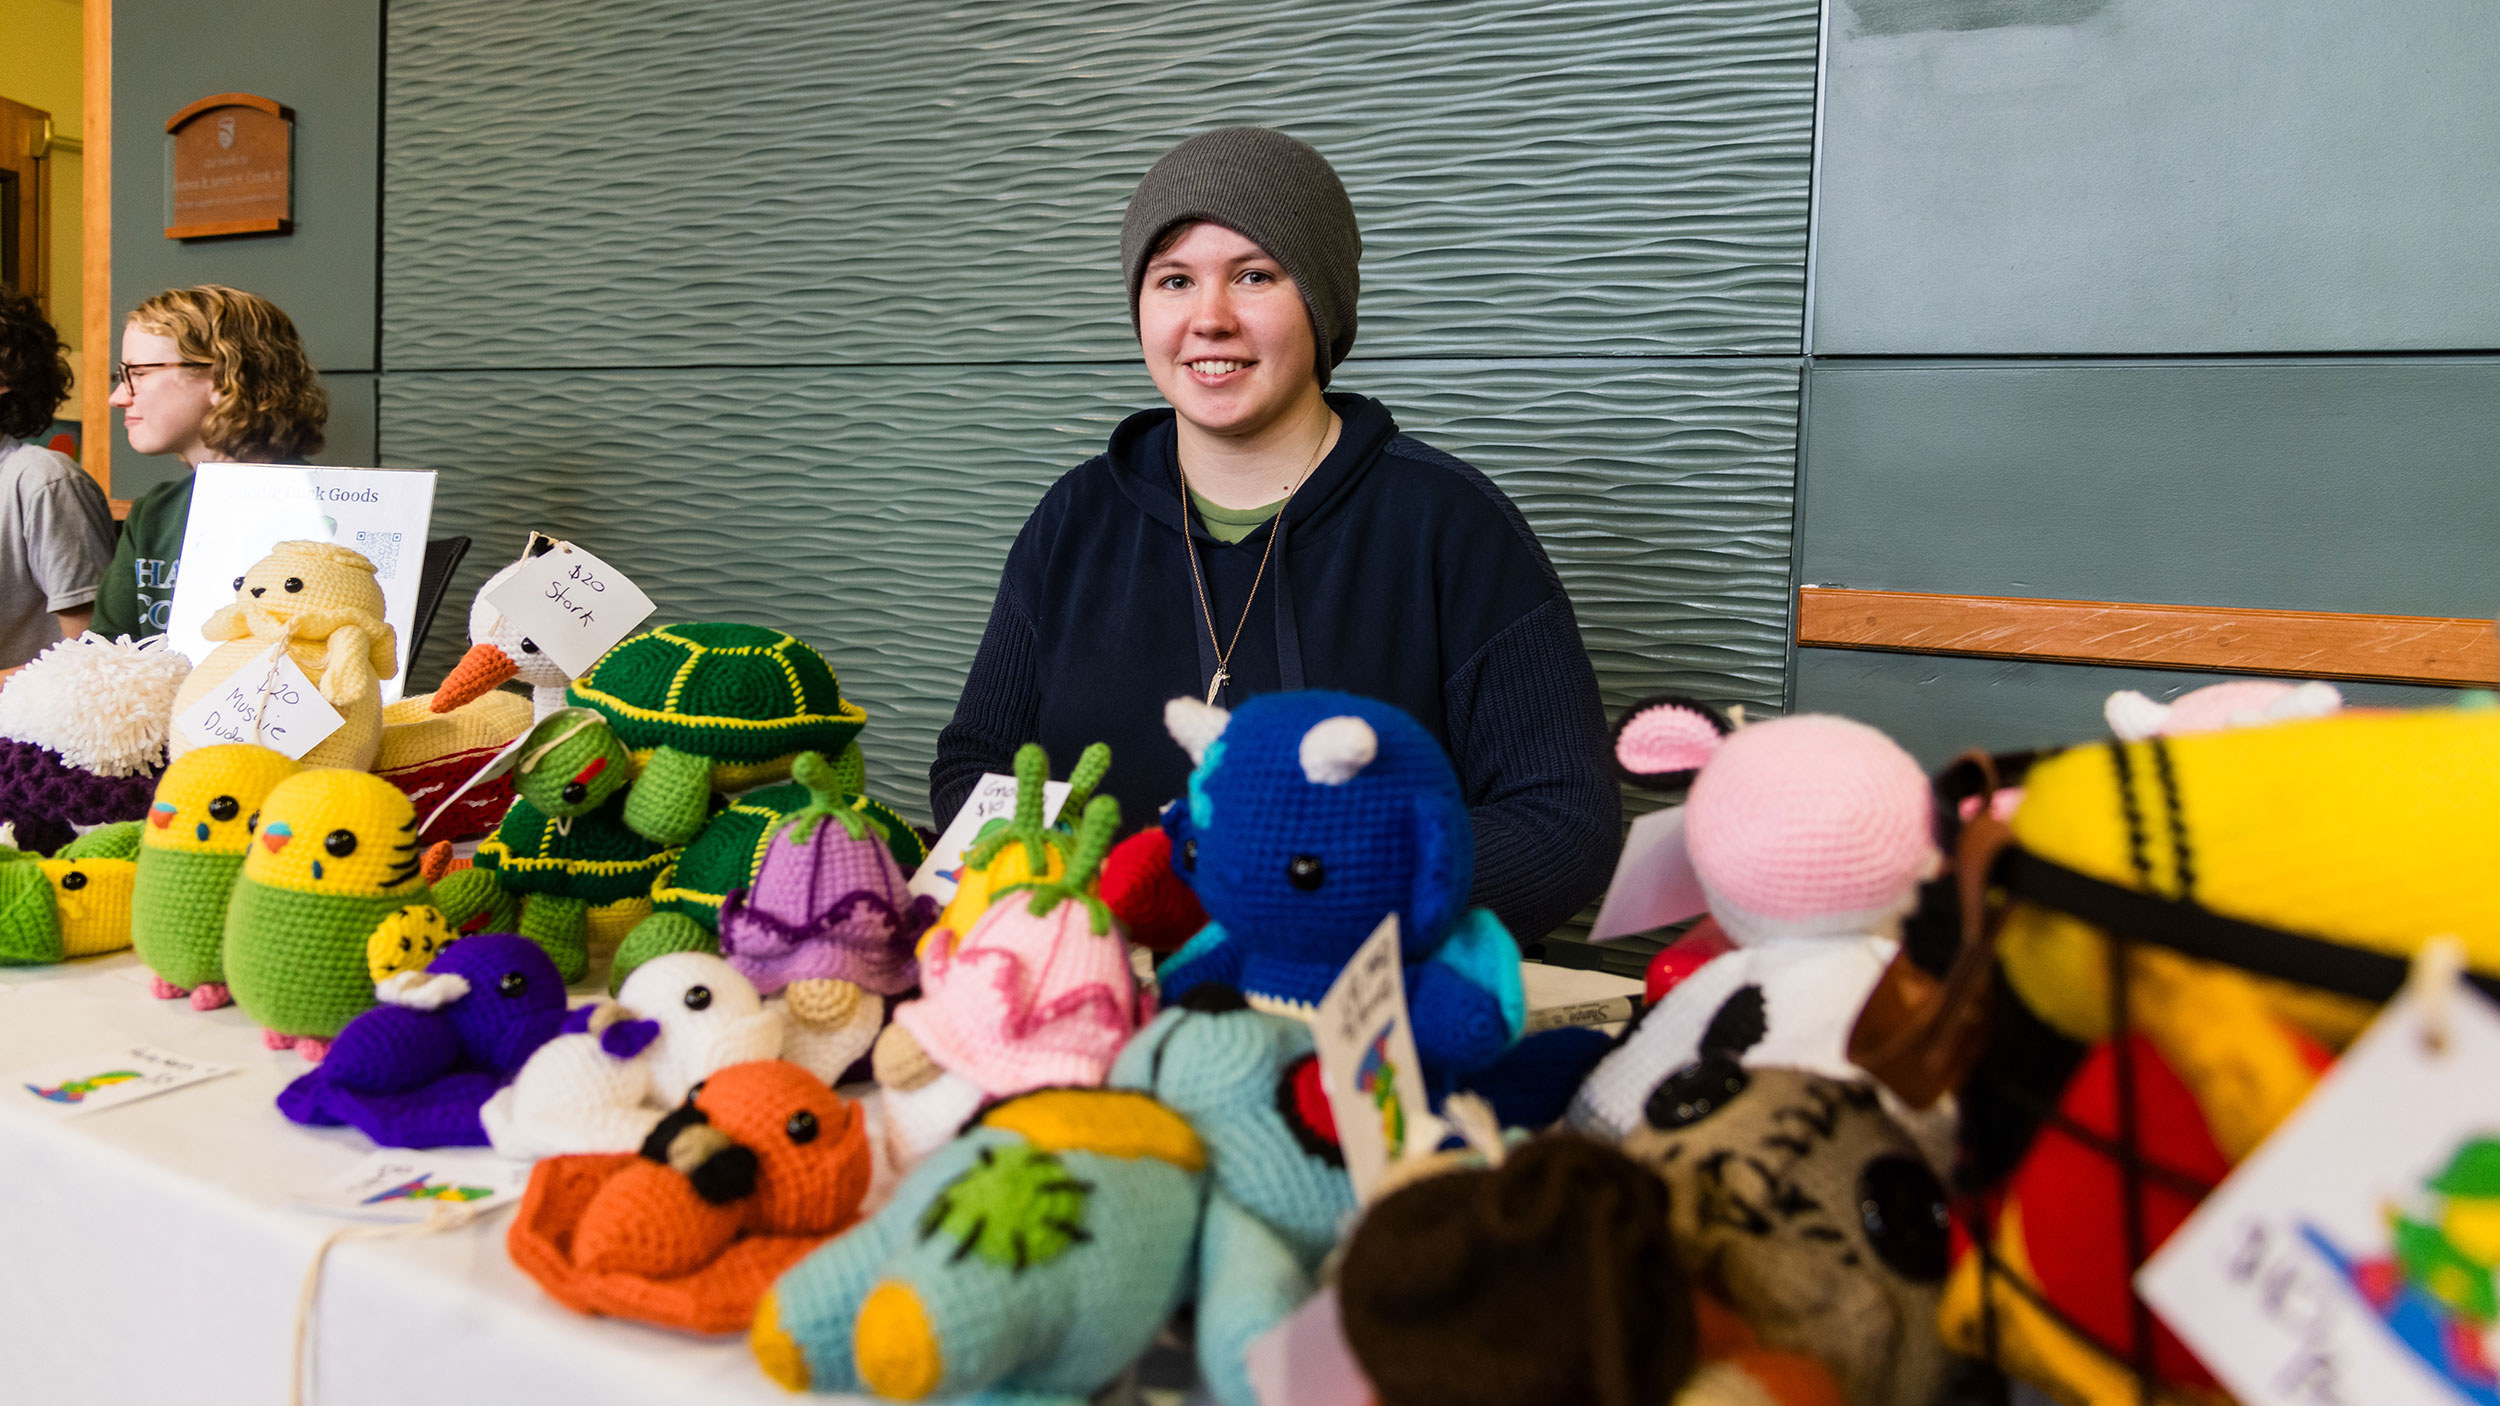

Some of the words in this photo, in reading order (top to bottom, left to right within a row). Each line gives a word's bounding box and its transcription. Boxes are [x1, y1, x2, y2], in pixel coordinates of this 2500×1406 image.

[328, 487, 379, 503] Goods
[568, 564, 605, 593] $20
[545, 581, 595, 628] Stork
[257, 667, 300, 705] $20
[203, 711, 245, 743] Dude
[976, 801, 1005, 817] $10
